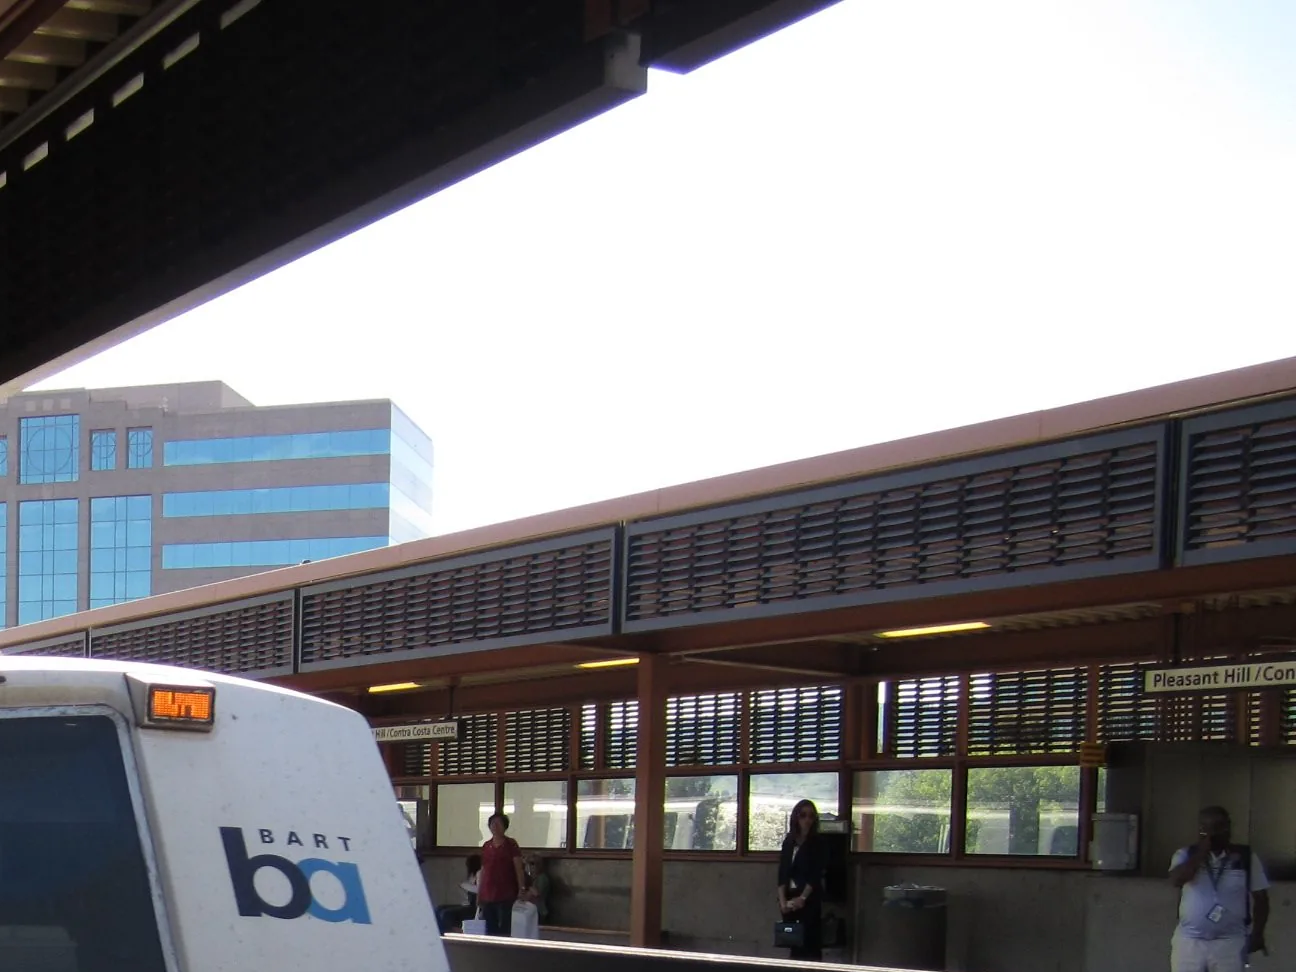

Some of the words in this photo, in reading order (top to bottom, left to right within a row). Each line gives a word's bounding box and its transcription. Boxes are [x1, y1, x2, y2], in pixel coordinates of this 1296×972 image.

[1154, 671, 1219, 688] Pleasant
[1224, 666, 1251, 683] Hill
[412, 726, 431, 737] Costa
[432, 724, 455, 735] Centre
[259, 828, 352, 851] BART
